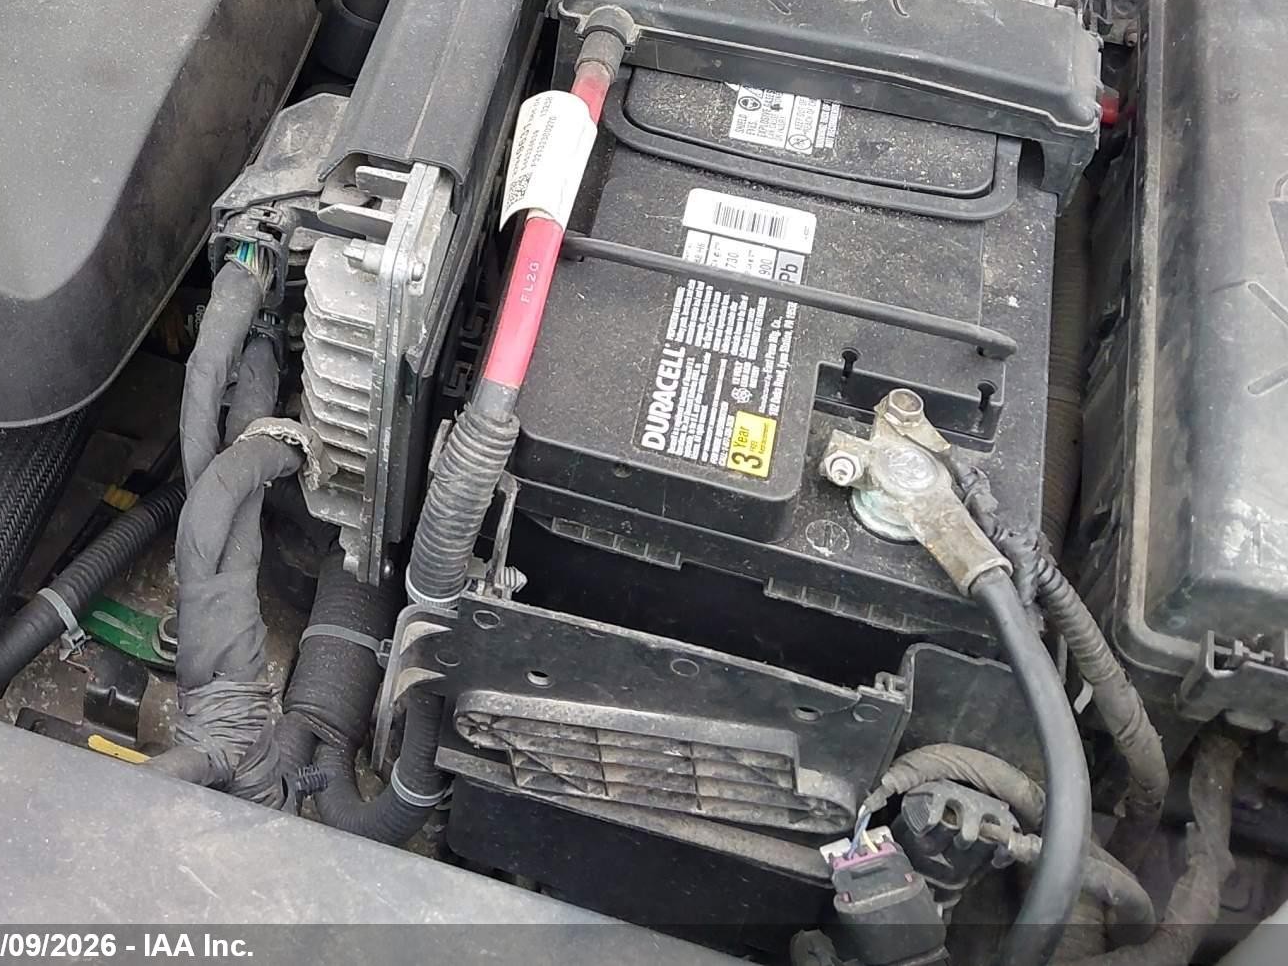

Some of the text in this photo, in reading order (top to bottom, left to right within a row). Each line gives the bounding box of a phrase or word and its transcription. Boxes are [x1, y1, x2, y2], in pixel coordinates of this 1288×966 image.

[725, 252, 739, 268] 730
[758, 258, 772, 275] 900
[779, 263, 799, 283] Pb
[520, 261, 539, 303] FL2G
[641, 344, 687, 450] DURACELL
[732, 426, 763, 469] 3 Year
